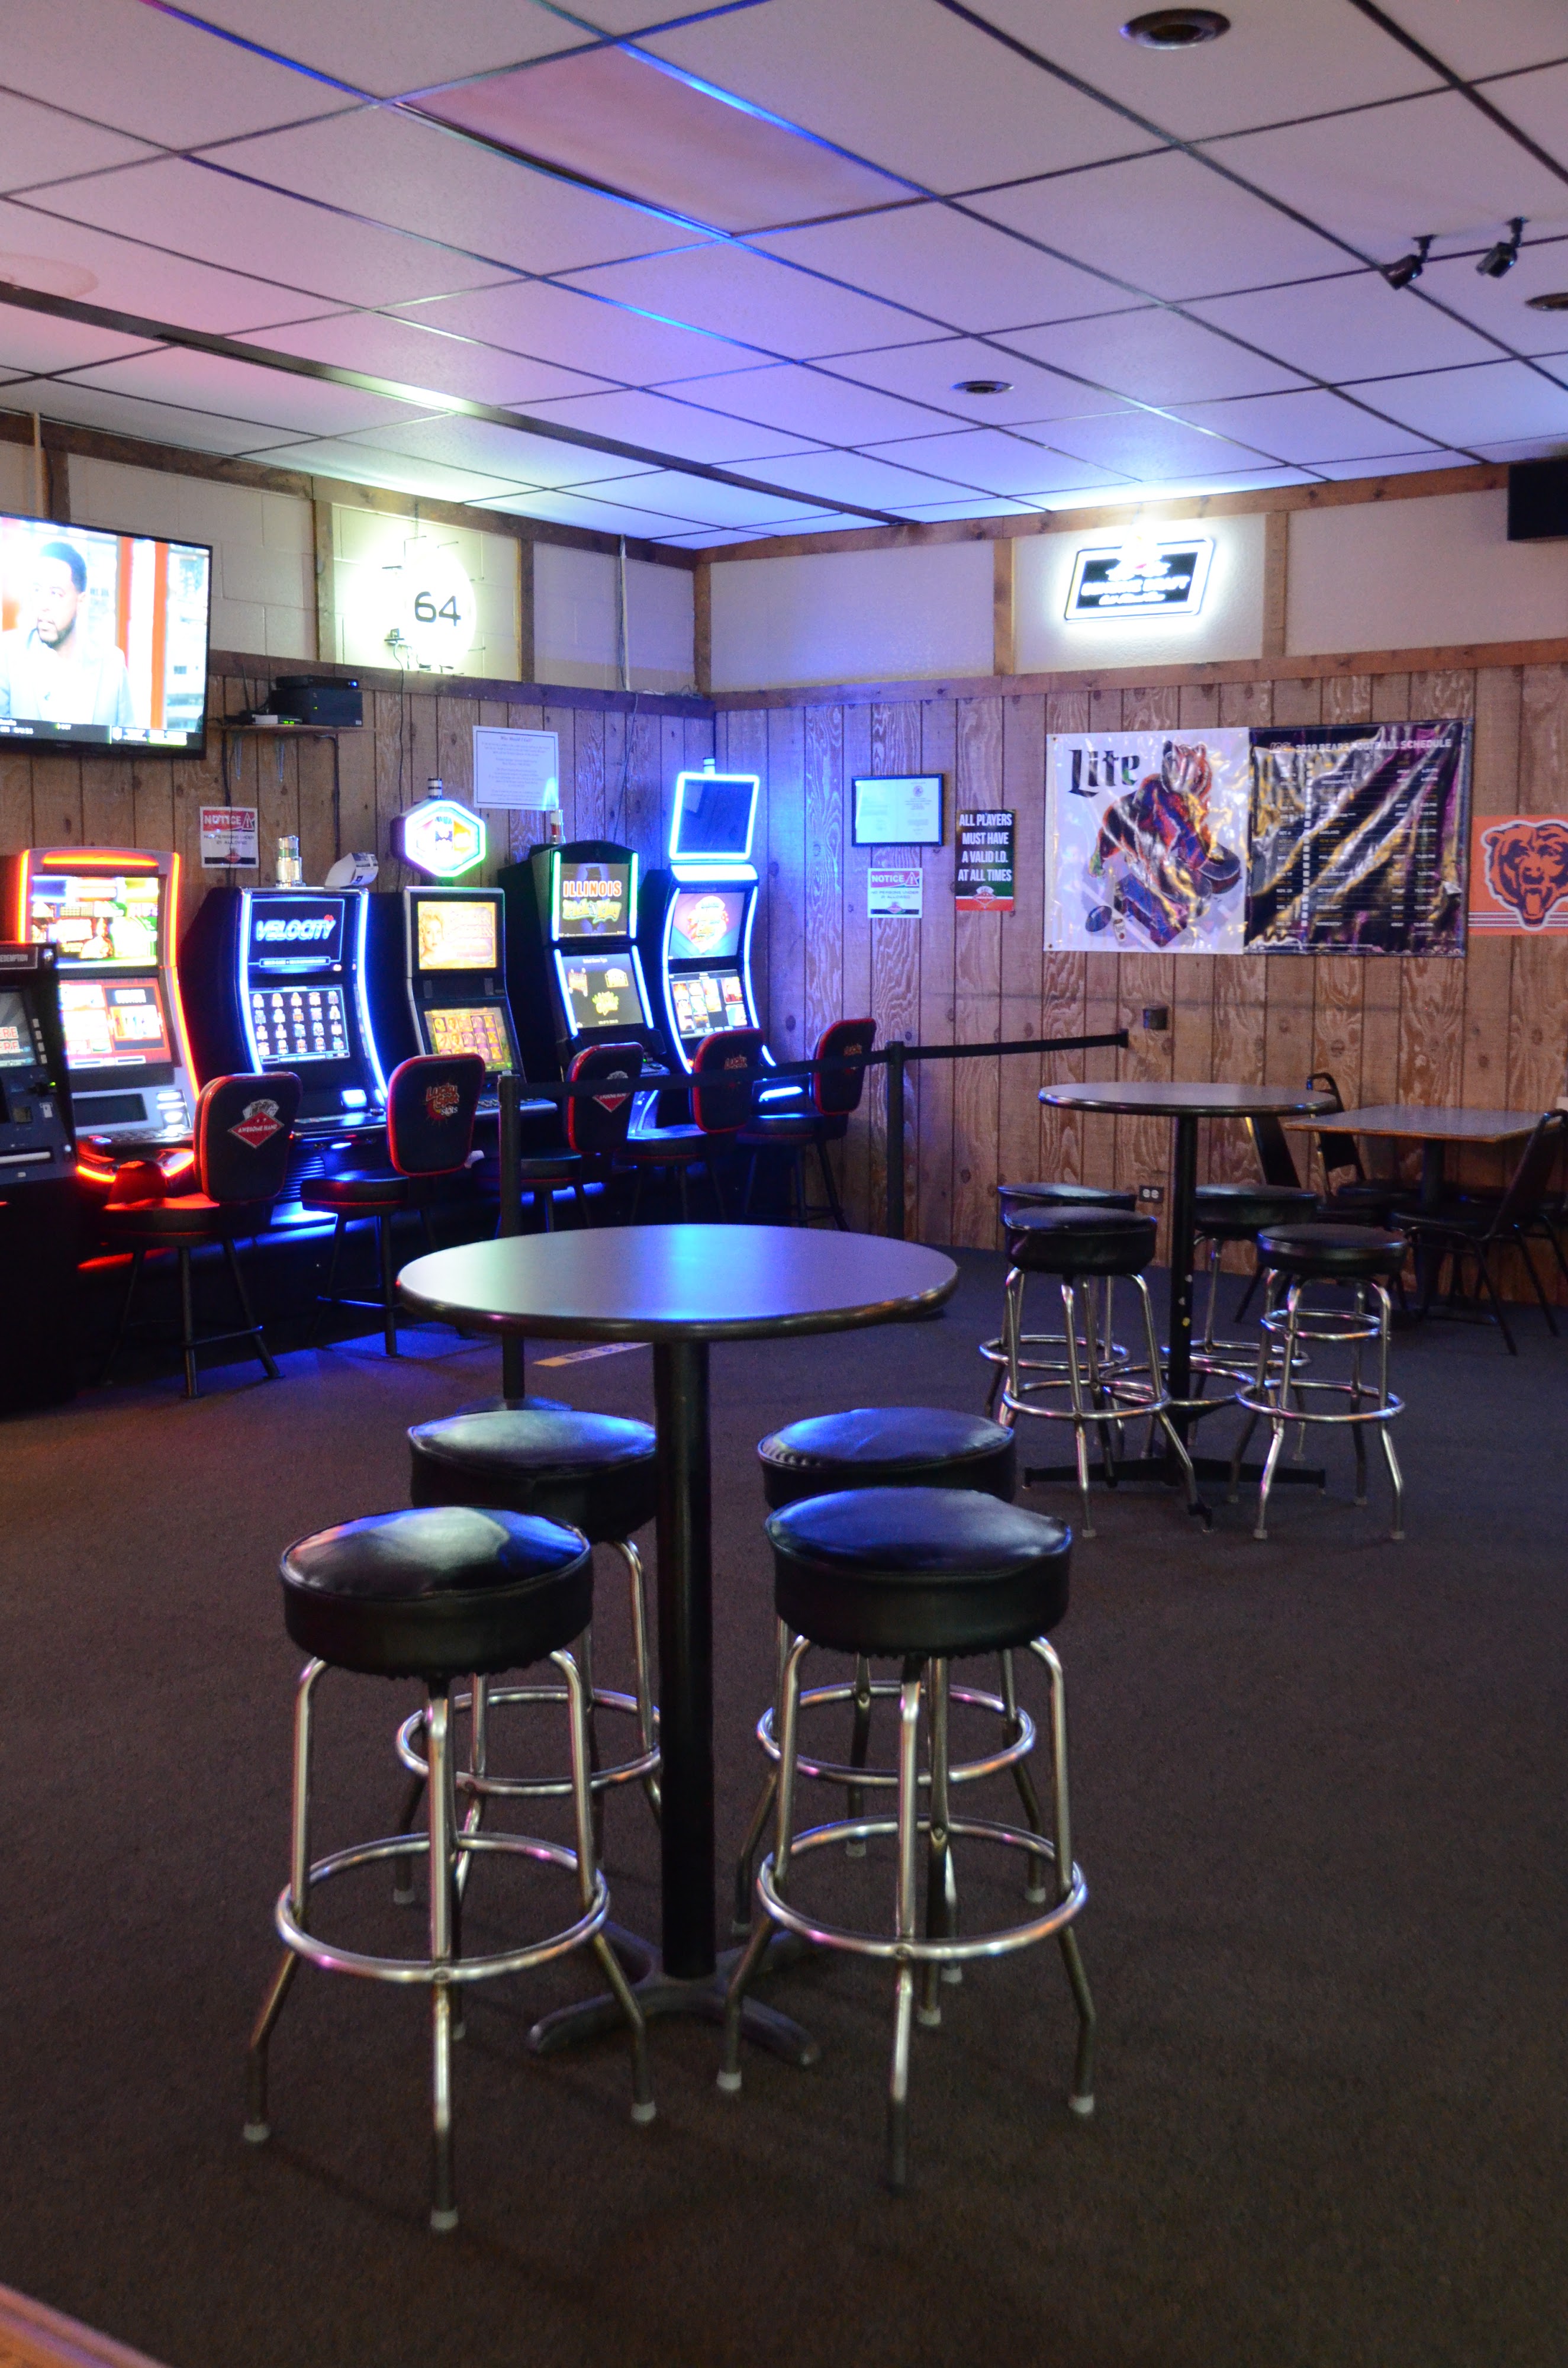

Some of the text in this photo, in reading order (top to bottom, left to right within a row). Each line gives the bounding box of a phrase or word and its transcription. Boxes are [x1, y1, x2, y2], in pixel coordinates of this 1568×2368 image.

[414, 591, 462, 626] 64
[1400, 739, 1451, 749] SCHEDULE
[1068, 749, 1140, 798] Lite
[204, 814, 242, 825] NOTICE
[959, 813, 1012, 826] ALL PLAYERS
[962, 832, 1009, 845] MUST HAVE
[961, 851, 1009, 863] A VALID I.D.
[871, 874, 904, 883] NOTICE
[958, 869, 1012, 881] AT ALL TIMES
[563, 880, 622, 897] ILLINOIS
[256, 919, 336, 941] VELOCITY
